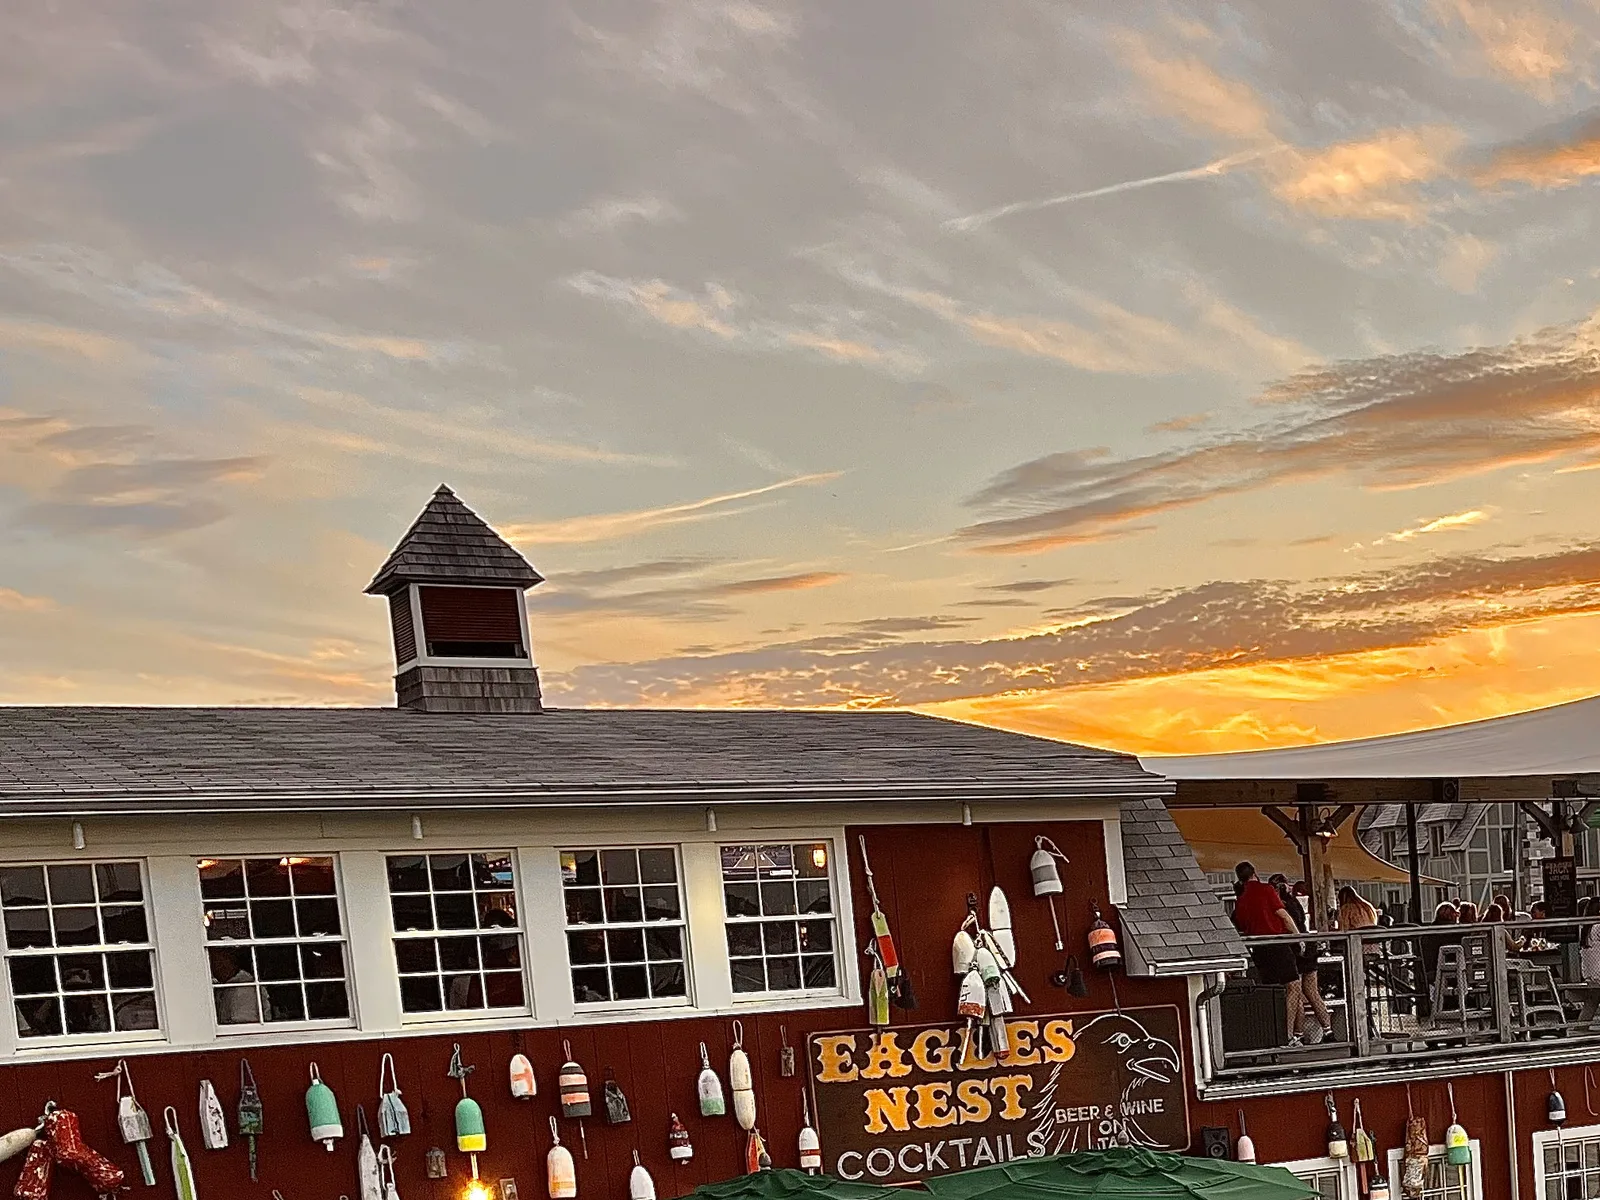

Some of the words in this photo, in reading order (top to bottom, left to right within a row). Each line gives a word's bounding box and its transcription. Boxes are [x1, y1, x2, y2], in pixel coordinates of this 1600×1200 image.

[814, 1019, 1076, 1083] EAGLES
[863, 1074, 1033, 1134] NEST
[1055, 1105, 1101, 1124] BEER
[1104, 1104, 1114, 1119] &
[1121, 1099, 1165, 1115] WINE
[1098, 1119, 1128, 1134] ON
[1098, 1136, 1126, 1149] TA
[837, 1131, 1046, 1180] COCKTAILS
